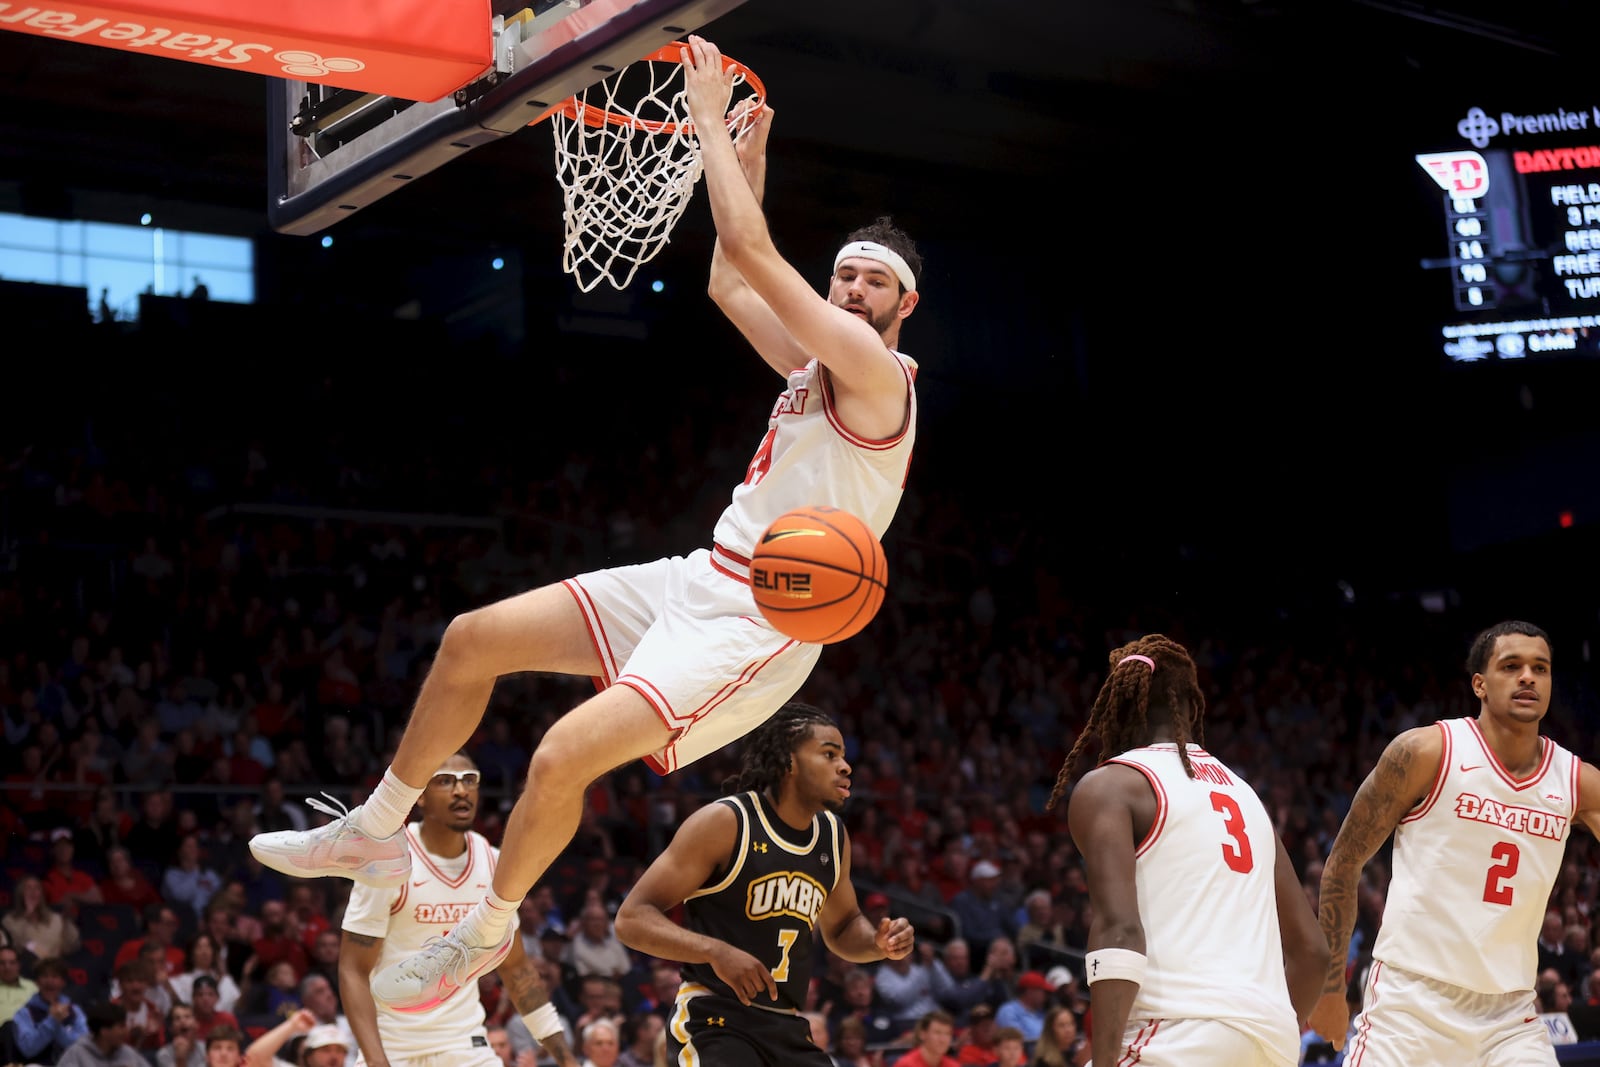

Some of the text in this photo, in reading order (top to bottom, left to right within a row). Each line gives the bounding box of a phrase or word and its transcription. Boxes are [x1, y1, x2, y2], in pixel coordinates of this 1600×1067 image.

[1501, 107, 1590, 136] Premier
[1209, 791, 1254, 875] 3
[1454, 792, 1568, 842] DAYTON
[1482, 841, 1520, 907] 2
[770, 928, 800, 983] 7
